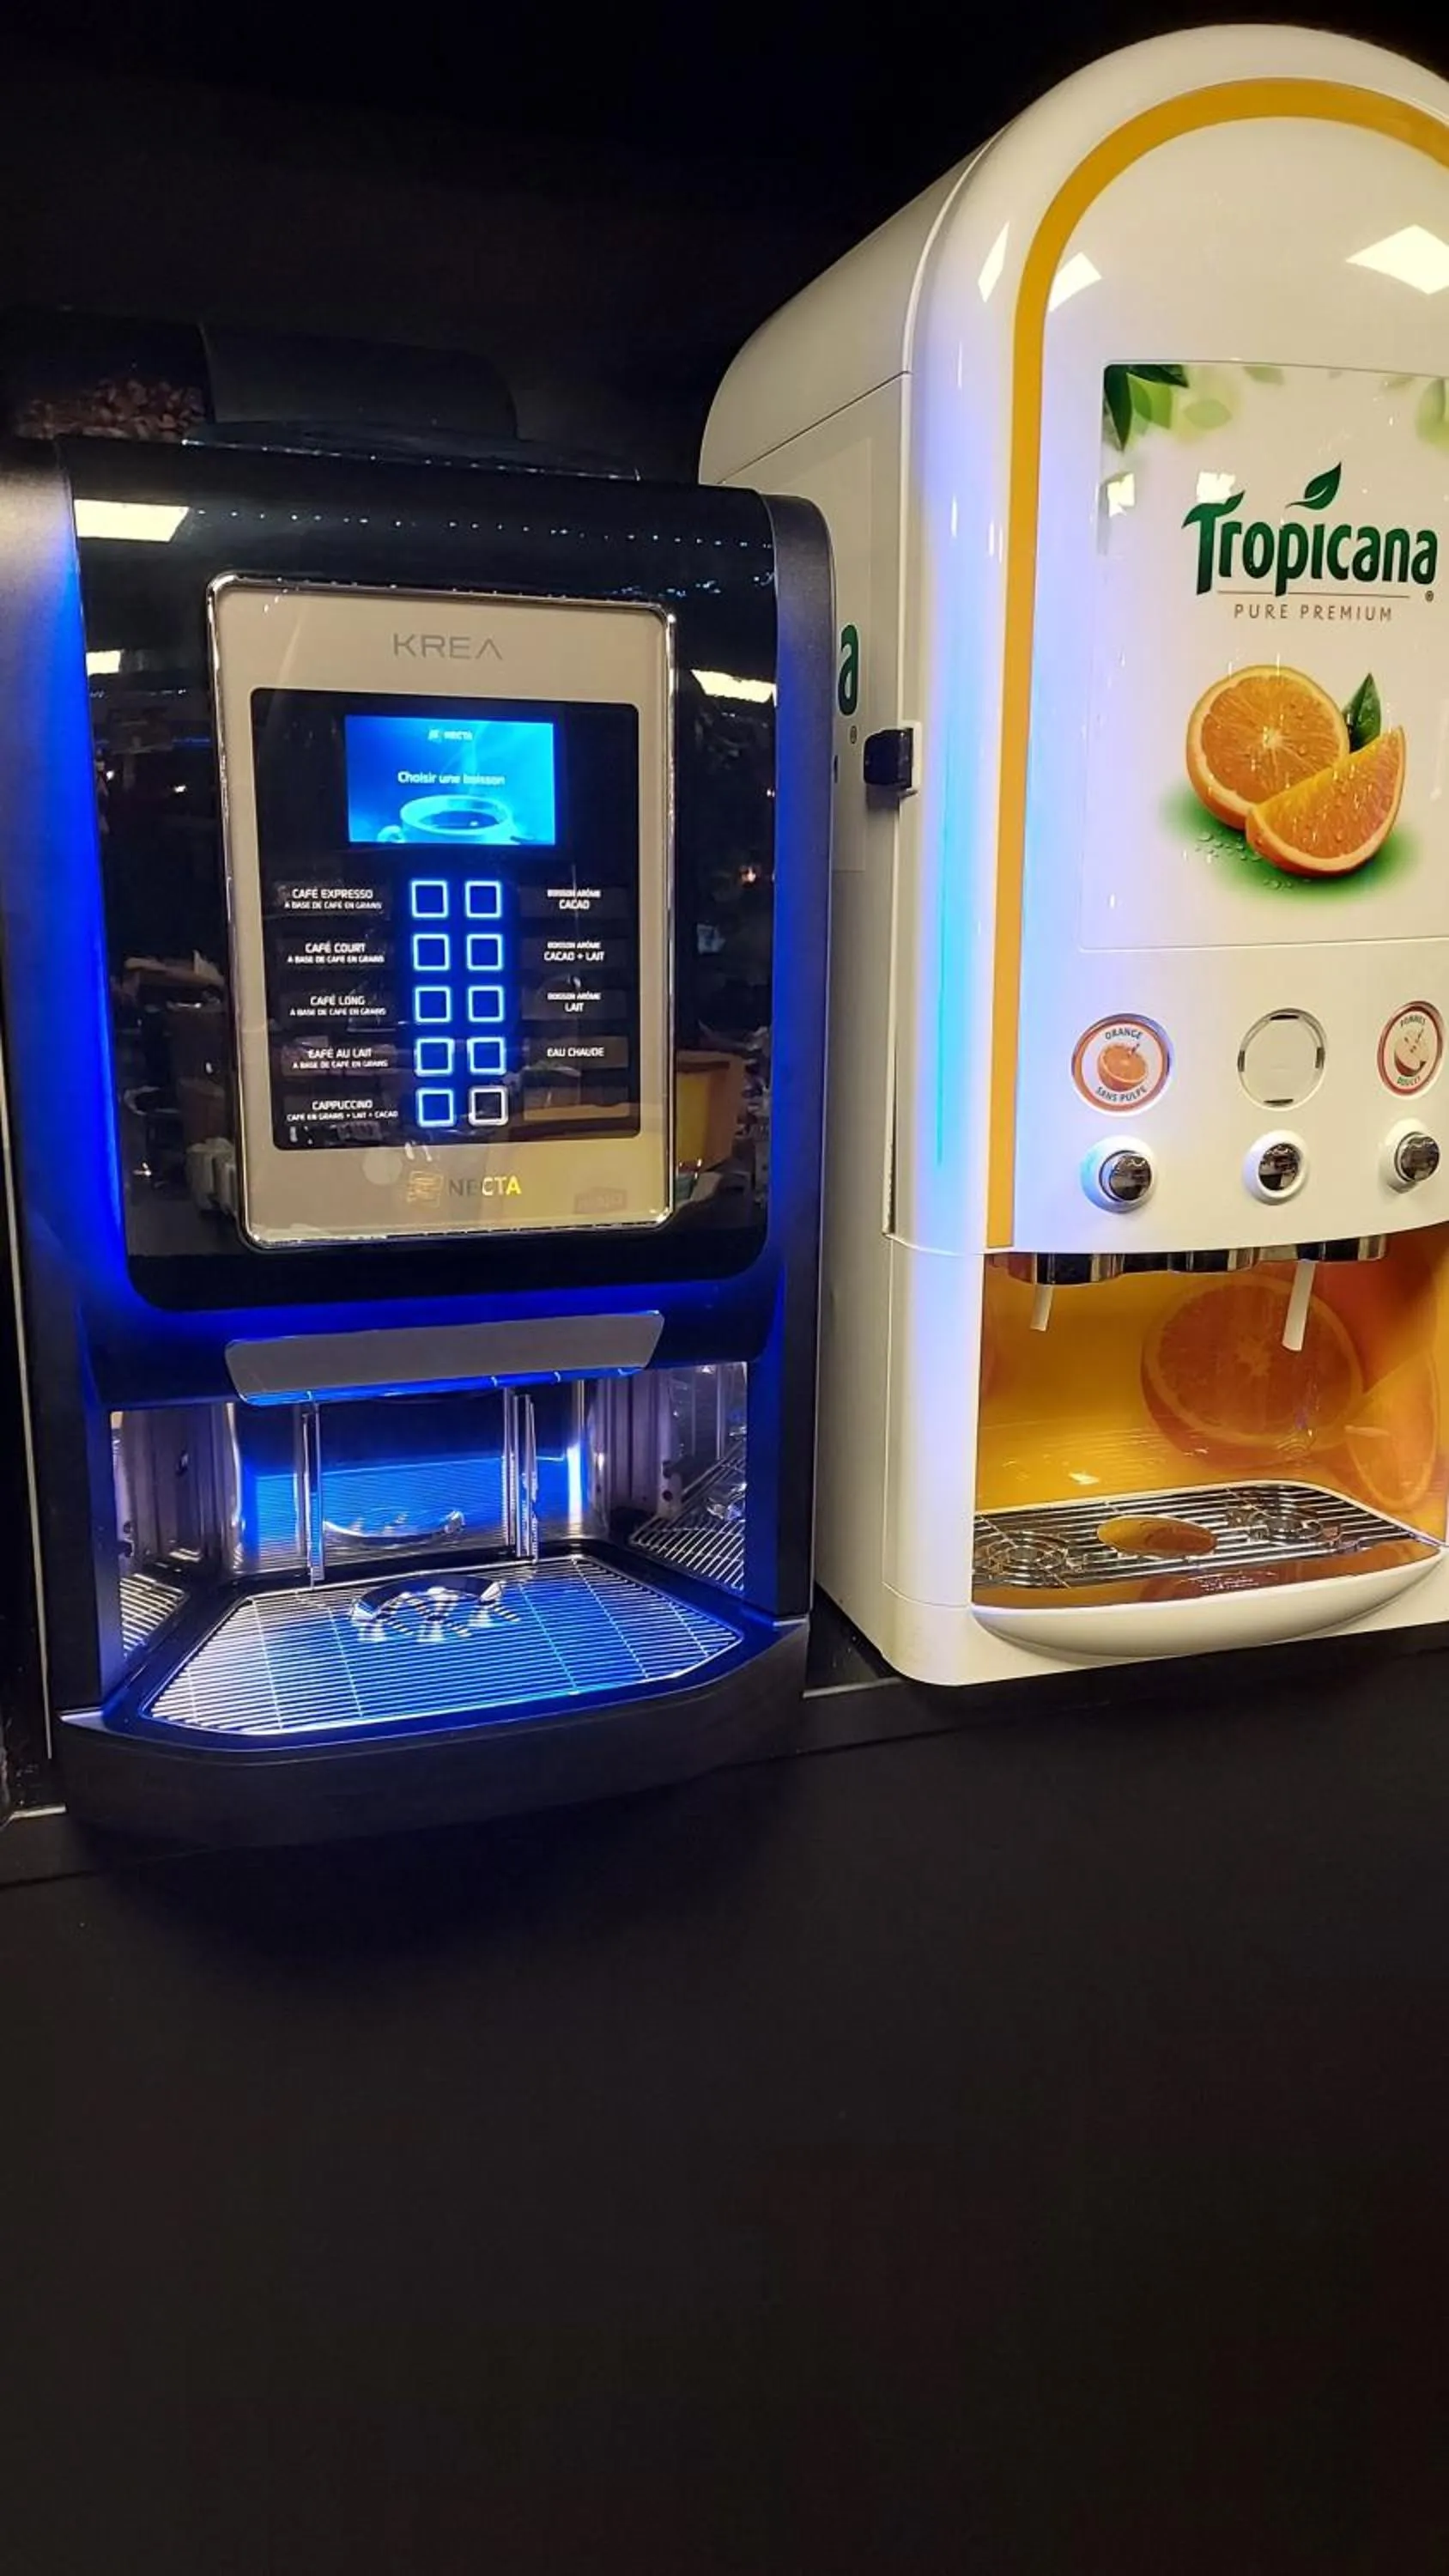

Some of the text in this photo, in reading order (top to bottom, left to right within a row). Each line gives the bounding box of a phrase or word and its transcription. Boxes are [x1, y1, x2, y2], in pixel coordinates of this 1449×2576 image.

[1181, 490, 1439, 596] Tropicana
[1234, 604, 1392, 622] PURE PREMIUM
[393, 632, 503, 660] KREA
[397, 770, 506, 785] Choisir une boisson
[292, 885, 373, 899] CAFÉ EXPRESSO
[559, 899, 590, 909] CACAO
[305, 940, 367, 953] CAFÉ COURT
[315, 955, 325, 963] DE
[543, 951, 575, 961] CACAO
[585, 951, 605, 961] LAIT
[310, 993, 366, 1005] CAFÉ LONG
[317, 1007, 327, 1016] DE
[565, 1002, 585, 1012] LAIT
[1105, 1028, 1143, 1040] ORANGE
[308, 1047, 372, 1058] CAFÉ AU LAIT
[547, 1047, 604, 1057] EAU CHAUDE
[1095, 1086, 1118, 1102] SANS
[312, 1099, 373, 1110] CAPPUCCINO
[374, 1109, 399, 1118] CACAO
[448, 1175, 522, 1197] NECTA
